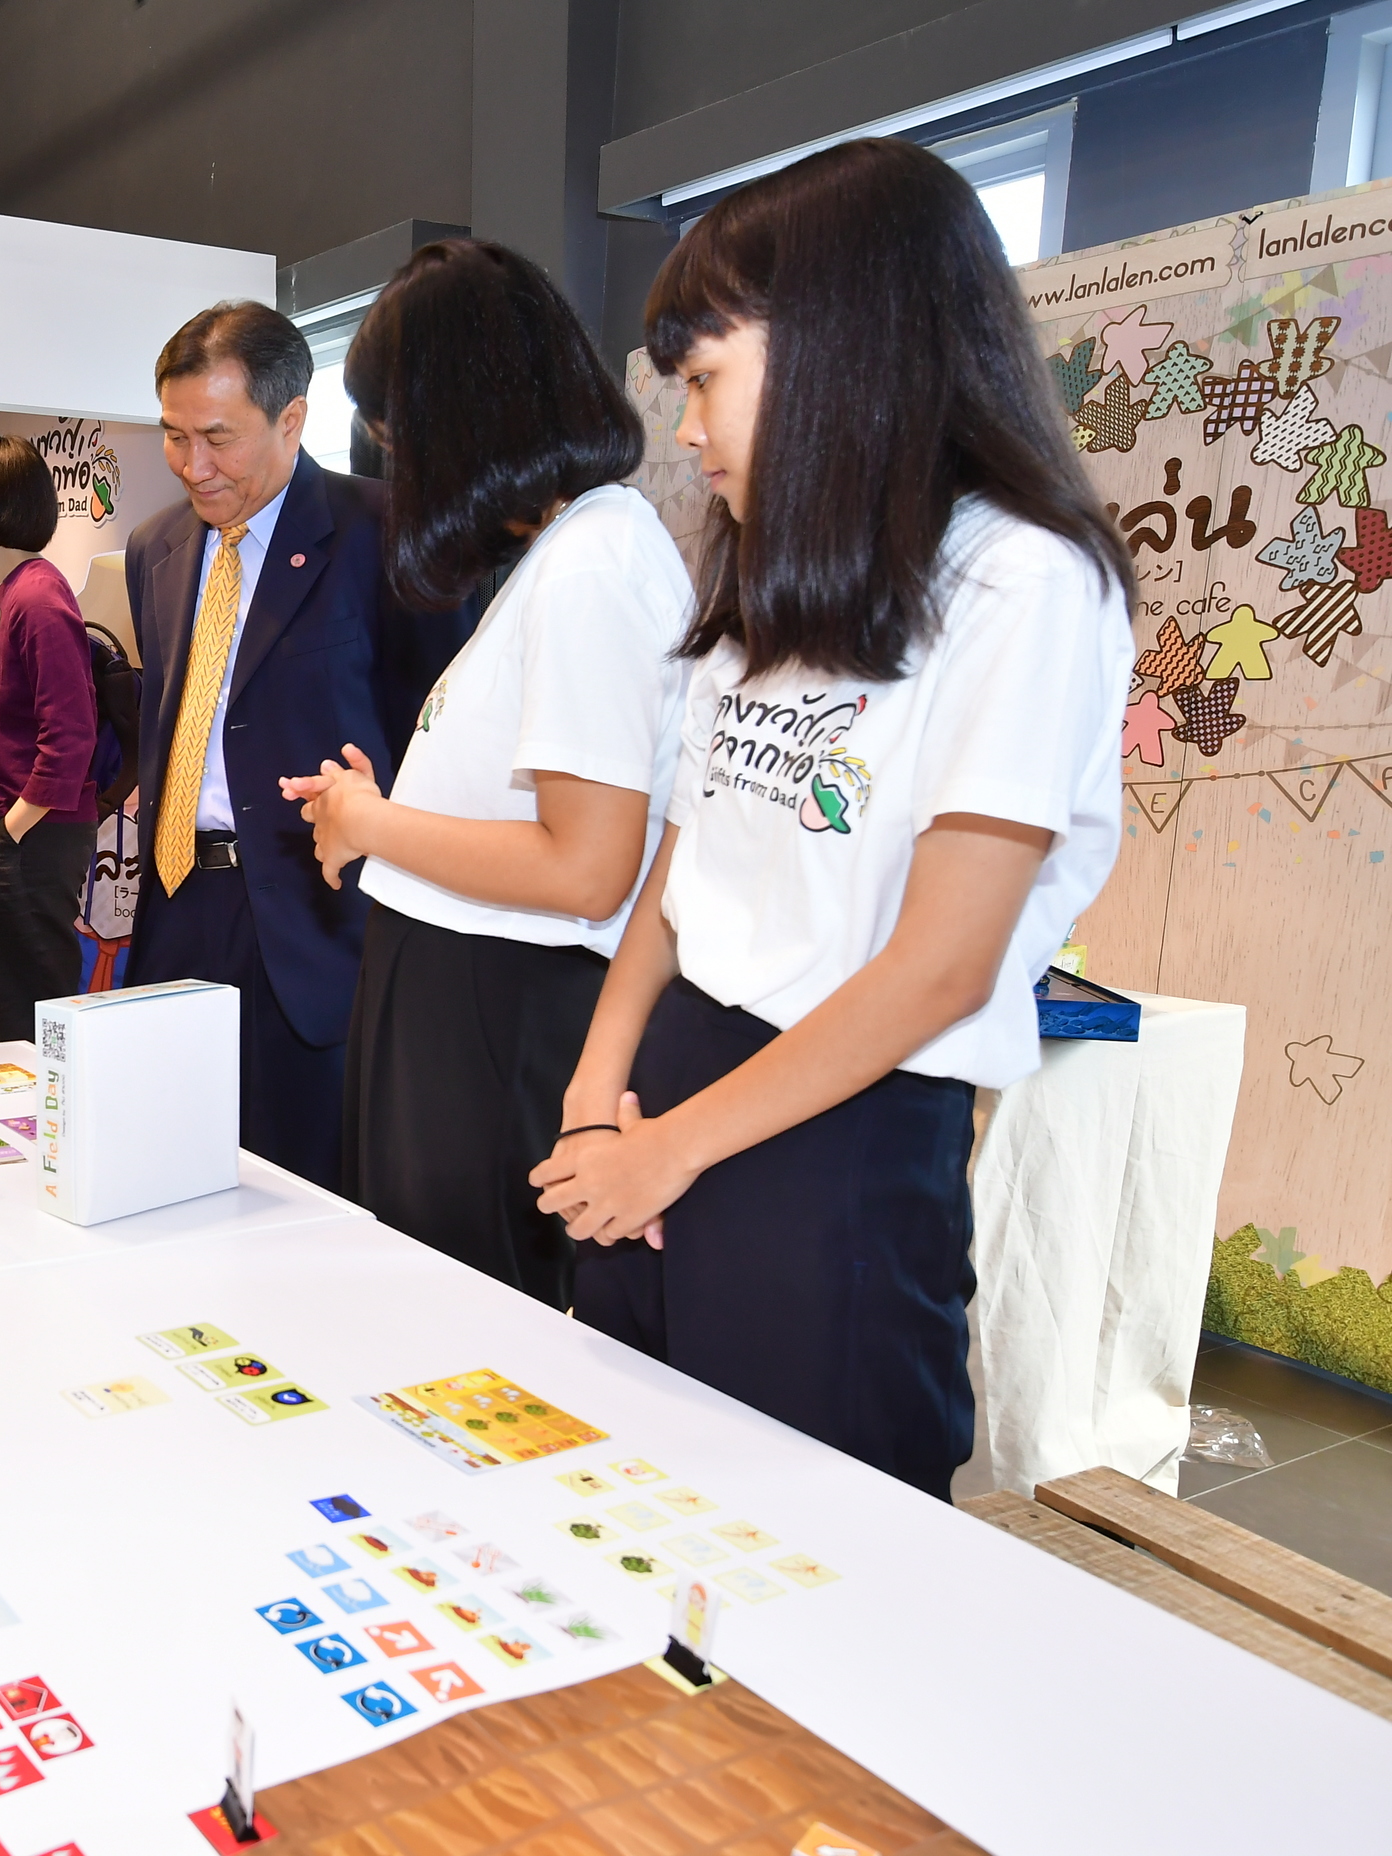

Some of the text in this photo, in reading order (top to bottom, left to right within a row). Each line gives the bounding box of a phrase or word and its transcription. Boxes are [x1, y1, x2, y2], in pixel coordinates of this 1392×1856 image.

[1258, 213, 1392, 260] lanlalenc
[1026, 254, 1216, 309] ww.lanlalen.com
[68, 496, 88, 512] Dad
[1176, 581, 1232, 616] cafe
[734, 772, 768, 798] from
[769, 786, 799, 811] Dad
[45, 1069, 60, 1111] Day
[43, 1120, 59, 1174] Field
